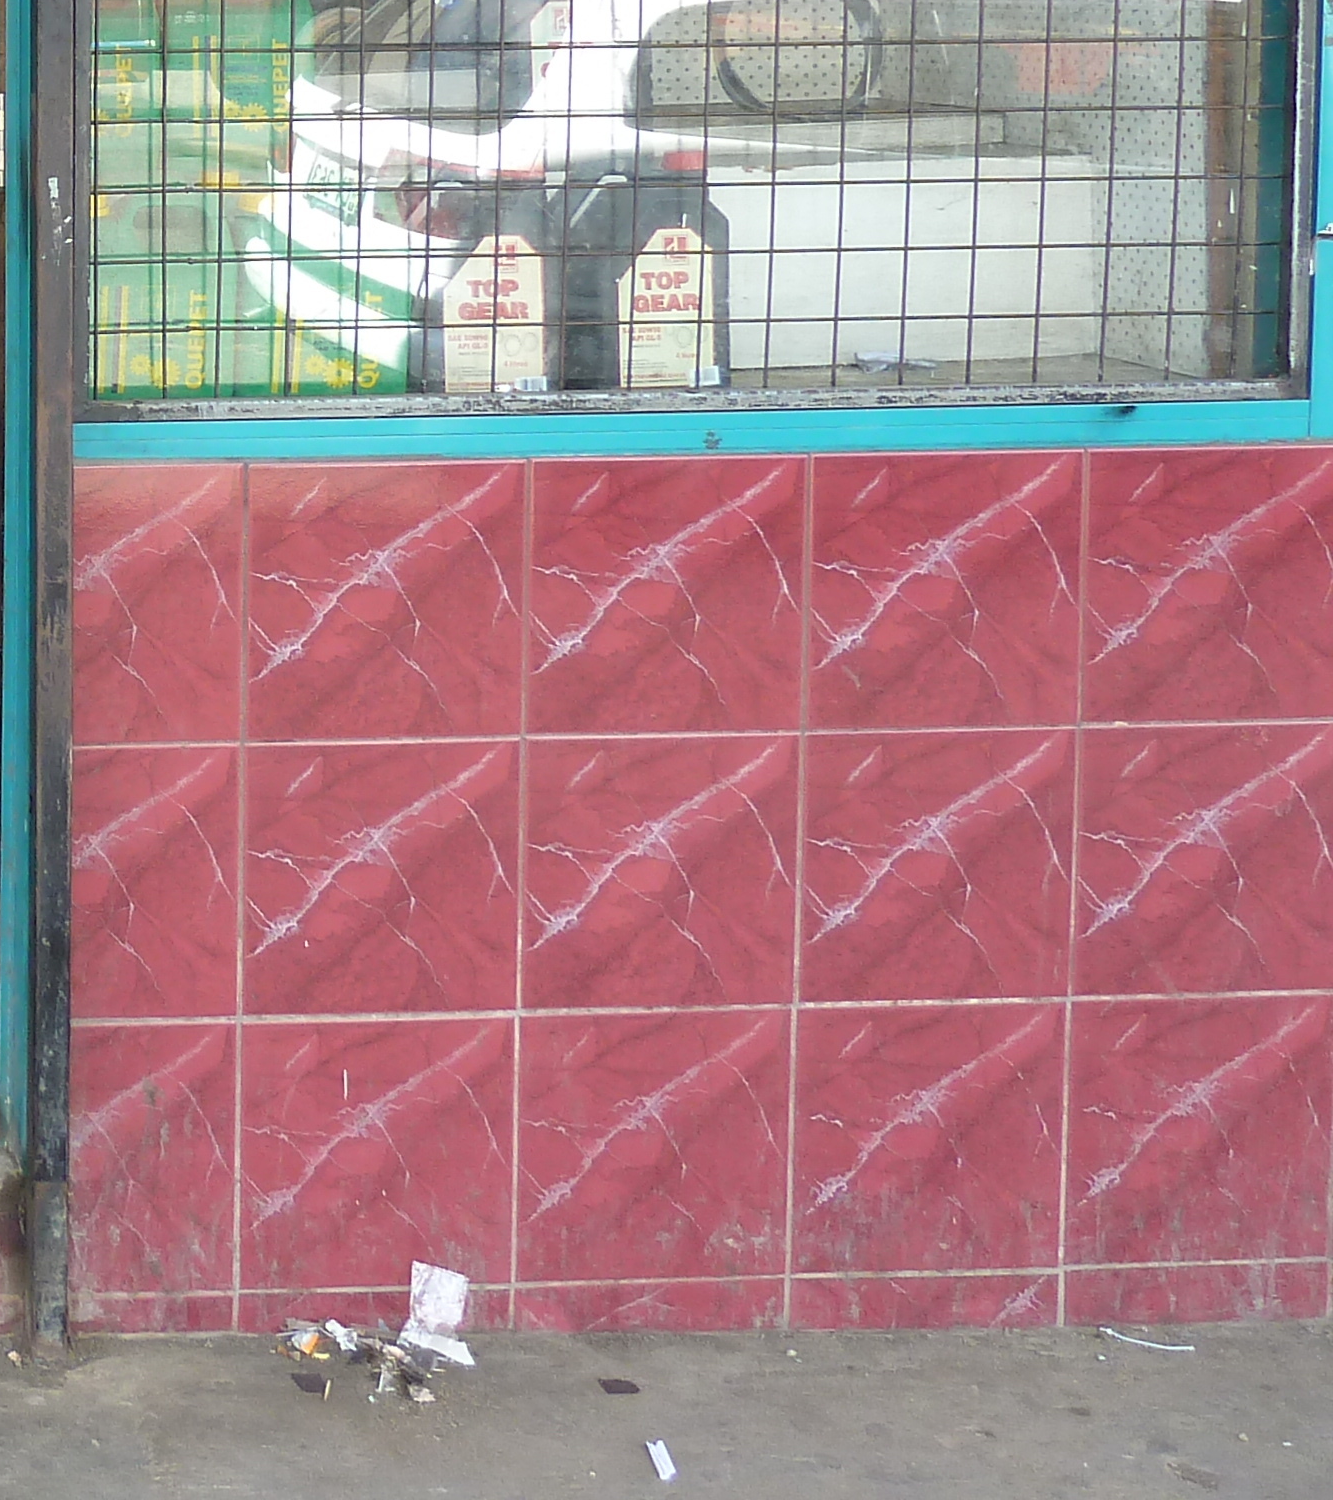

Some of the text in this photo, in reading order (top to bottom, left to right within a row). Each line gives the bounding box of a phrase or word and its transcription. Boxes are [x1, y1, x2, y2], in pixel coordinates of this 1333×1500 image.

[466, 279, 520, 298] TOP
[640, 271, 690, 291] TOP
[458, 301, 530, 321] GEAR
[633, 294, 700, 313] GEAR
